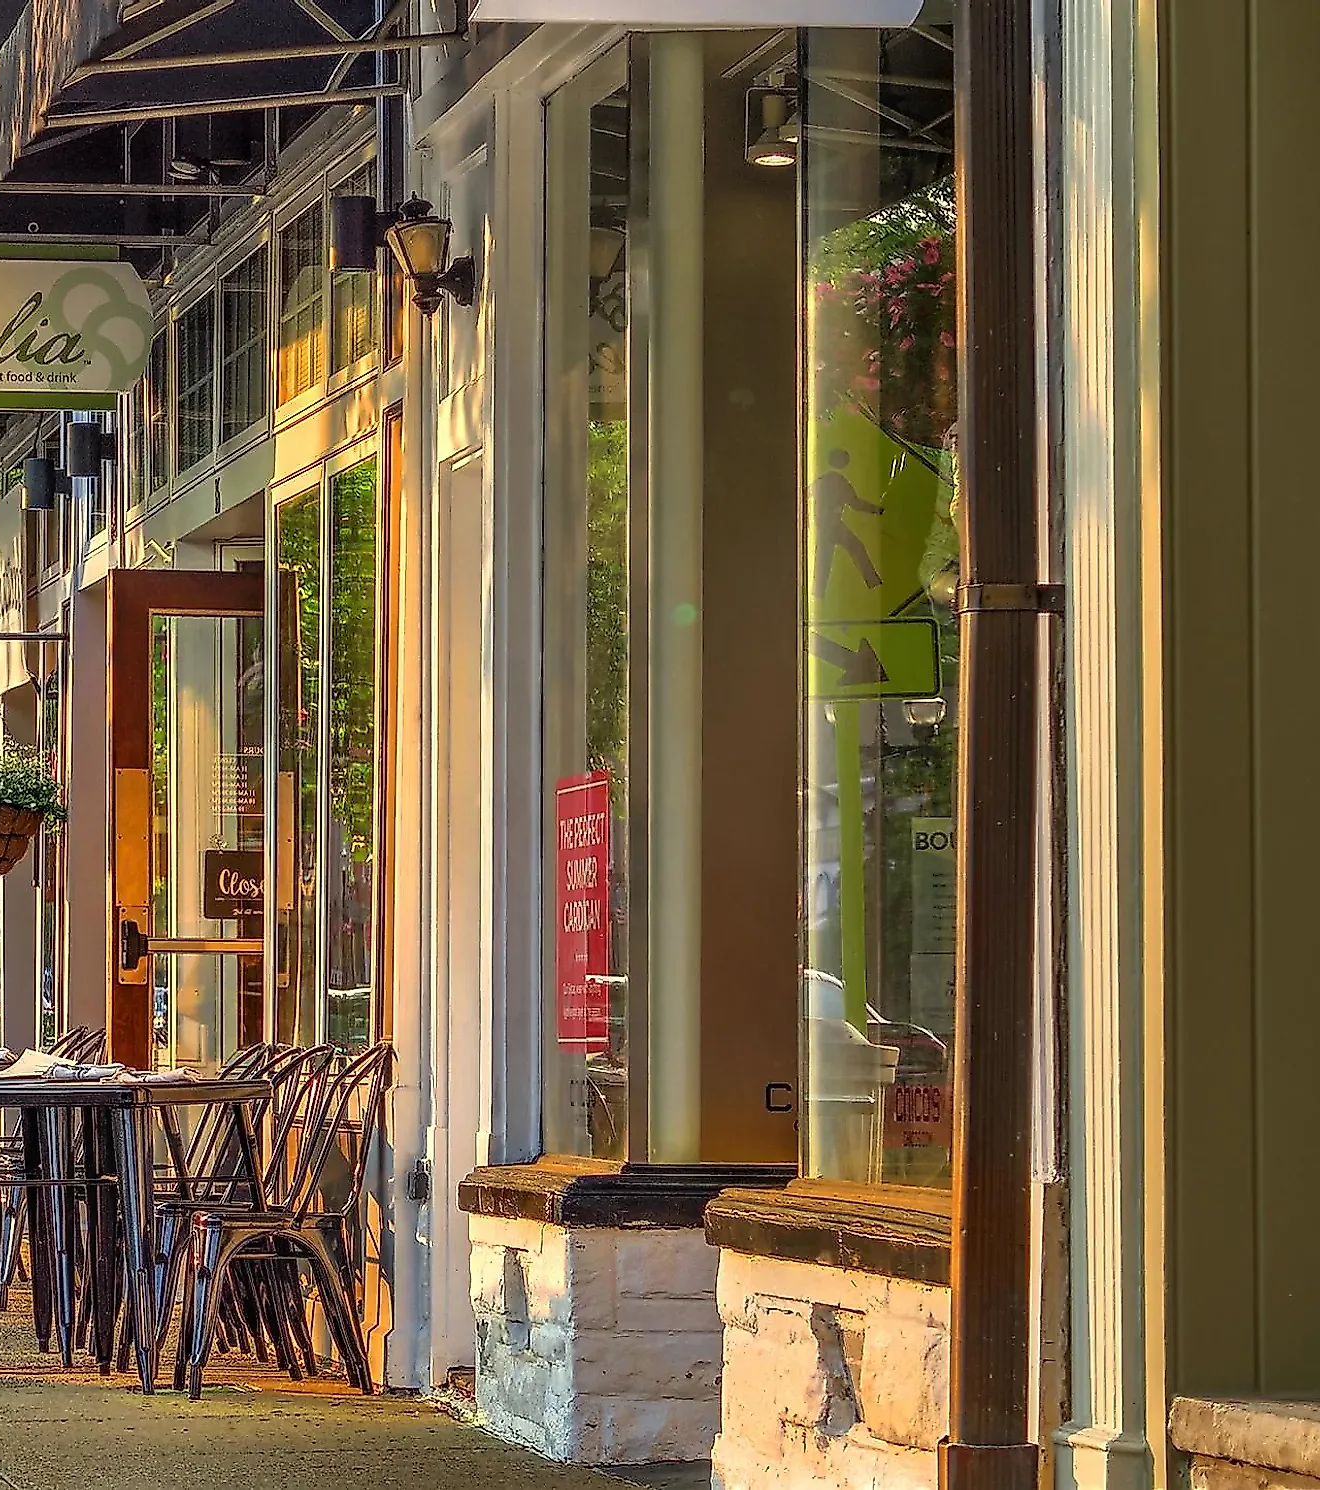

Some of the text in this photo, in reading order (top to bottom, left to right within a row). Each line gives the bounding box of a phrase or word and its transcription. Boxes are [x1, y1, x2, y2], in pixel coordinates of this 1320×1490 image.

[6, 371, 33, 382] food
[35, 372, 45, 382] &
[47, 372, 77, 383] drink
[560, 812, 606, 850] THE PERFECT
[567, 856, 598, 891] SUMMER
[563, 900, 601, 933] CARDIGAN
